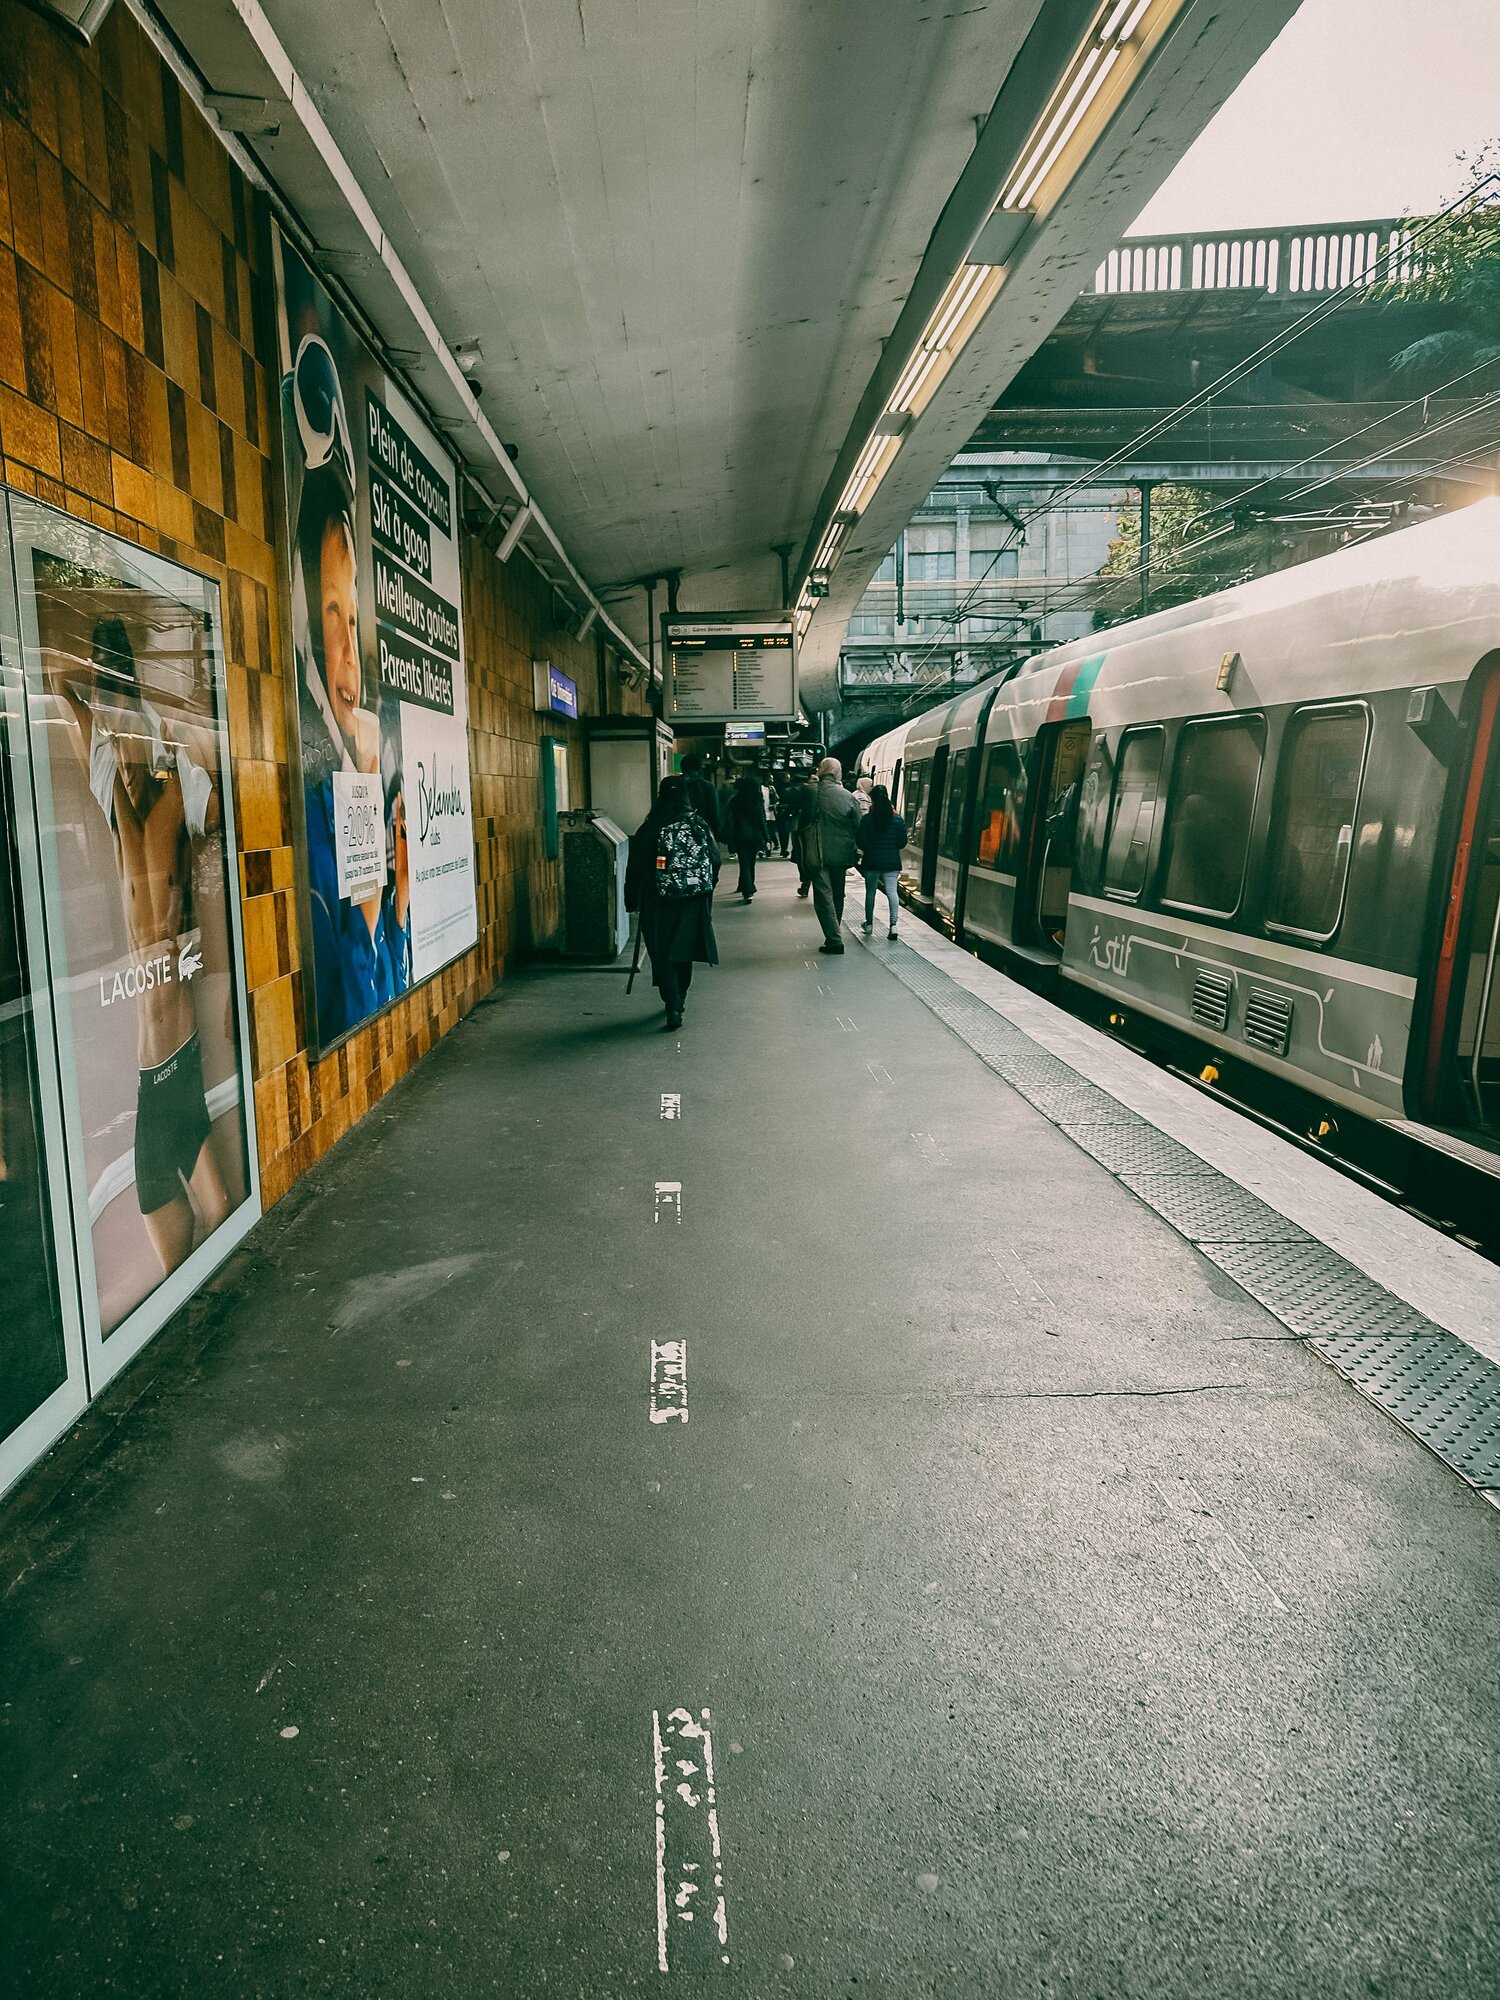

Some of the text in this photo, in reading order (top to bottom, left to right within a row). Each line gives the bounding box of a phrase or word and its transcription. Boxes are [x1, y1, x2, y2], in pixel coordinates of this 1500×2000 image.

[368, 401, 449, 527] Plein de copains
[372, 482, 429, 574] Ski à gogo
[377, 561, 458, 651] Meilleurs goûters
[380, 638, 452, 706] Parents libérés
[417, 752, 466, 848] Belambra
[430, 826, 441, 846] clubs
[99, 954, 172, 1008] LACOSTE
[1097, 933, 1132, 977] stif
[153, 1059, 178, 1085] LACOSTE
